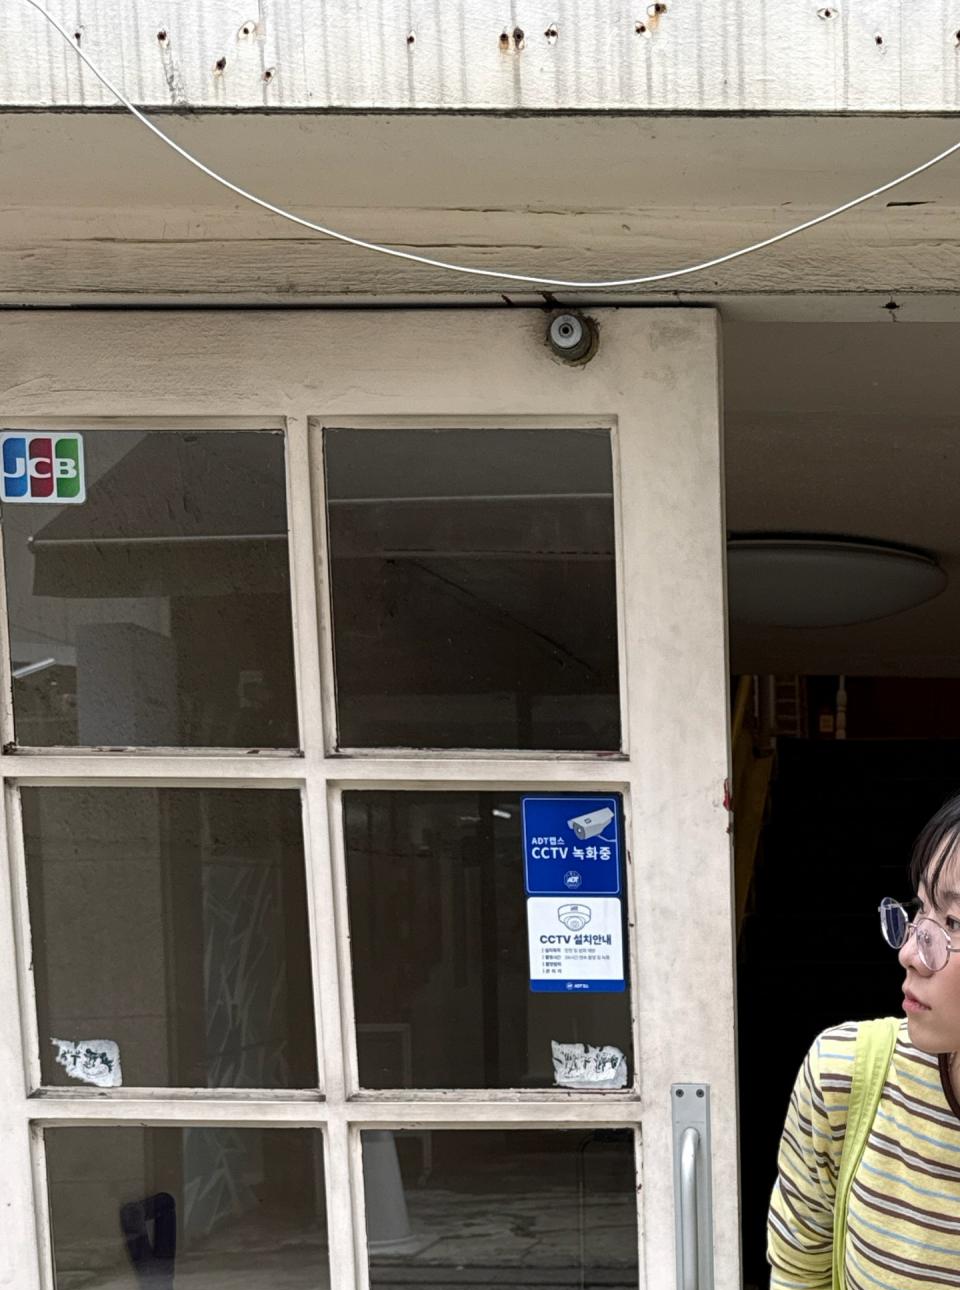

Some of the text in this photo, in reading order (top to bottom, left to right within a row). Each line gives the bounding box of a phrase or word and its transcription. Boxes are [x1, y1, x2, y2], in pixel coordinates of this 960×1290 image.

[3, 457, 78, 478] JCB
[531, 845, 612, 861] CCTV 녹화중
[539, 933, 612, 945] CCTV 설치안내
